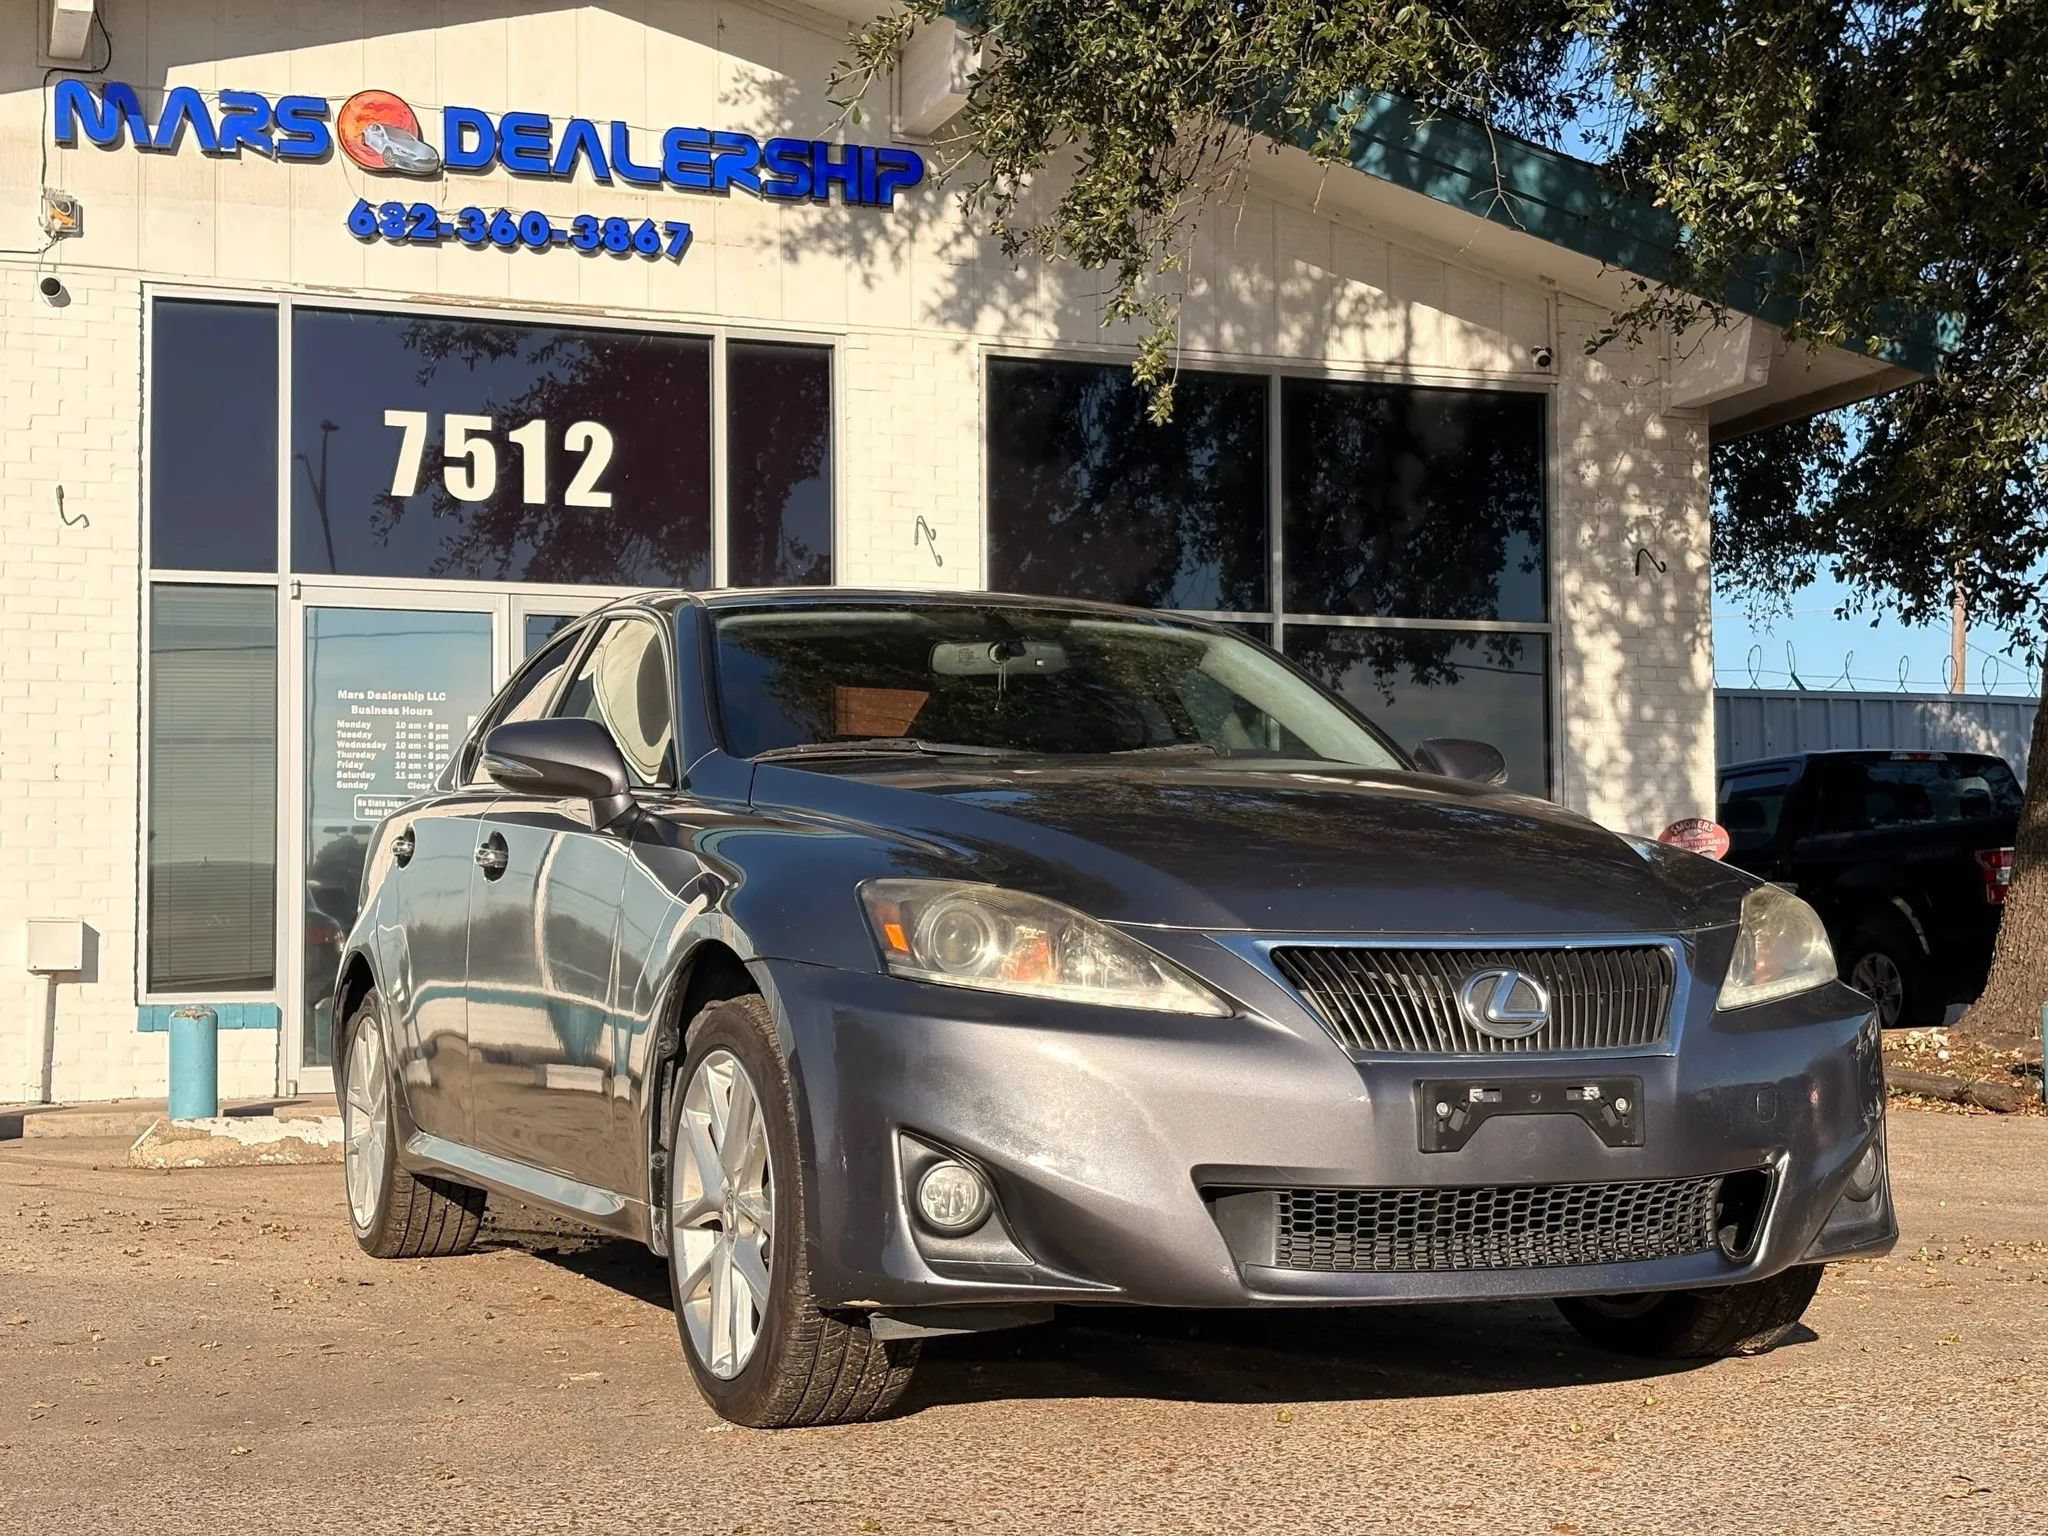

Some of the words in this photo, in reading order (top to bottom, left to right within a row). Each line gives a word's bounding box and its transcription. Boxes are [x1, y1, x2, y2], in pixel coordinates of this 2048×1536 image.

[55, 79, 331, 158] MARS
[443, 105, 924, 207] DEALERSHIP
[347, 198, 692, 261] 682-360-3867
[384, 409, 613, 508] 7512
[338, 690, 365, 699] Mars
[367, 691, 425, 702] Dealership
[427, 692, 446, 701] LLC
[351, 705, 400, 715] Business
[402, 706, 433, 715] Hours
[336, 720, 371, 729] Monday
[395, 721, 406, 729] 10
[336, 730, 372, 739] Tuesday
[395, 731, 406, 739] 10
[336, 740, 387, 750] Wednesday
[395, 741, 406, 749] 10
[336, 750, 376, 760] Thursday
[395, 751, 406, 759] 10
[336, 760, 364, 770] Friday
[395, 761, 406, 769] 10
[336, 770, 376, 780] Saturday
[395, 771, 406, 779] 11
[336, 780, 368, 790] Sunday
